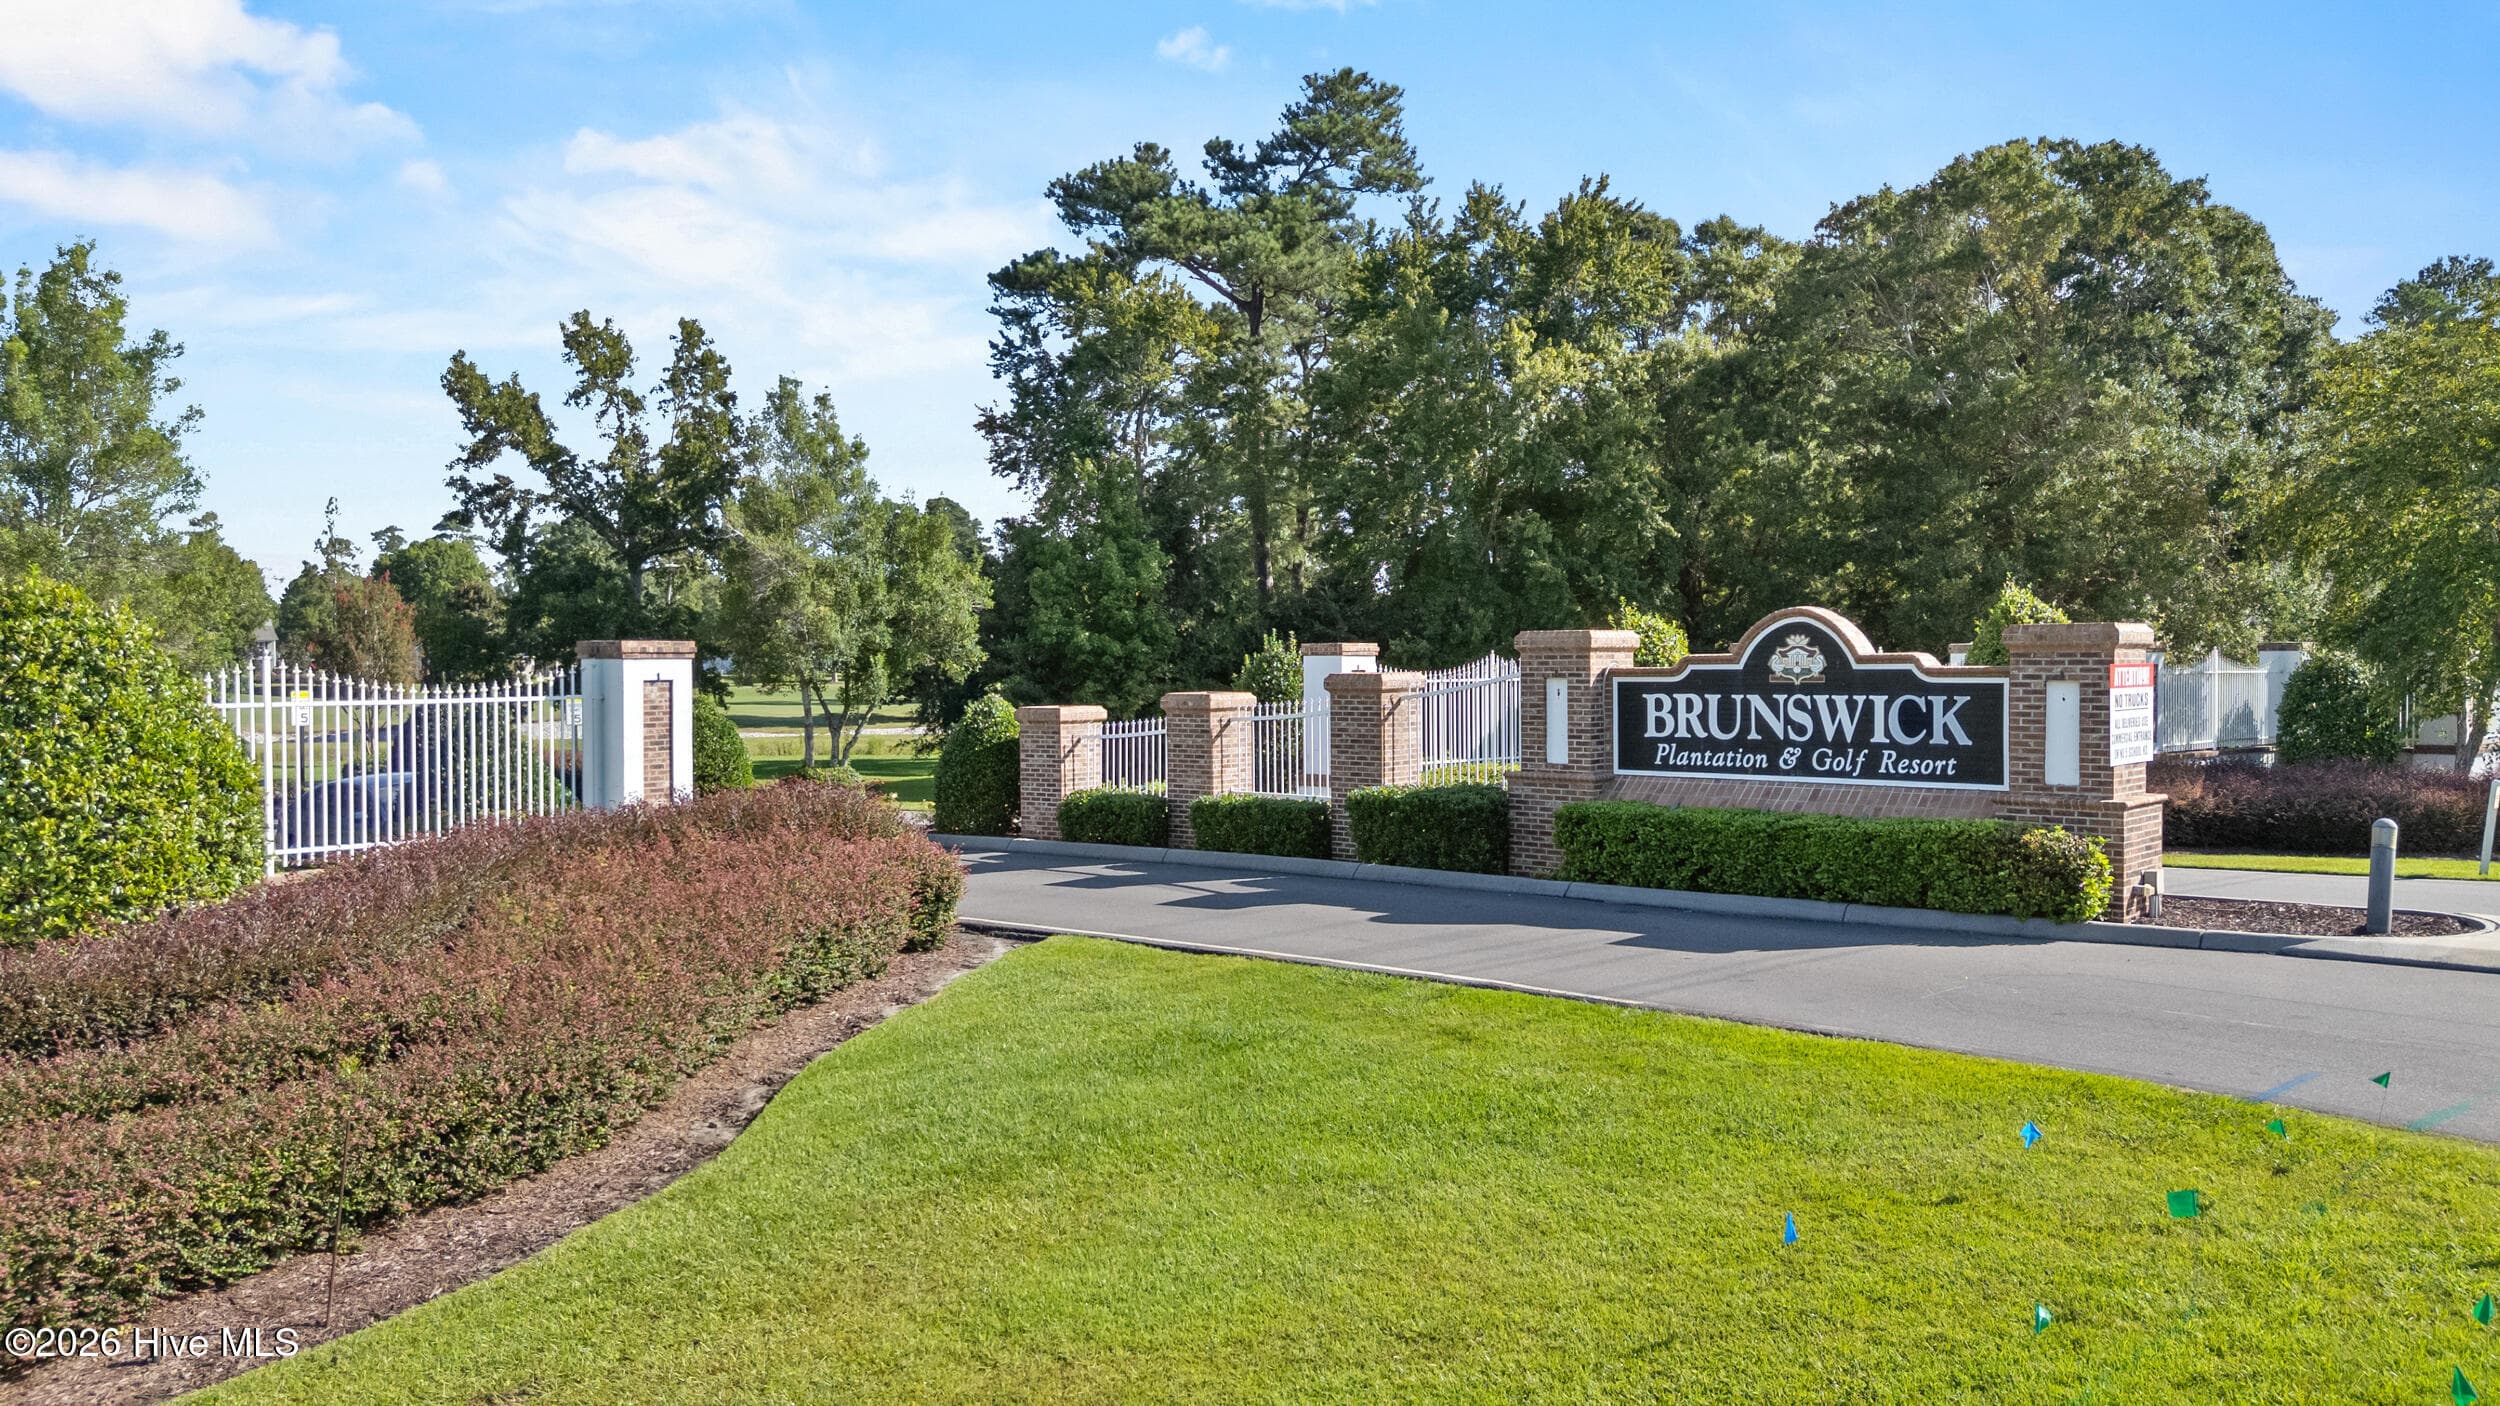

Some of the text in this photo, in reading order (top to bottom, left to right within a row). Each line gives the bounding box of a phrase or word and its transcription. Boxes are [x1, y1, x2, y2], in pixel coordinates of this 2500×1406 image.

[2115, 692, 2149, 708] NO TRUCKS
[1642, 693, 1972, 746] BRUNSWICK
[1654, 743, 1957, 777] Plantation & Golf Resort
